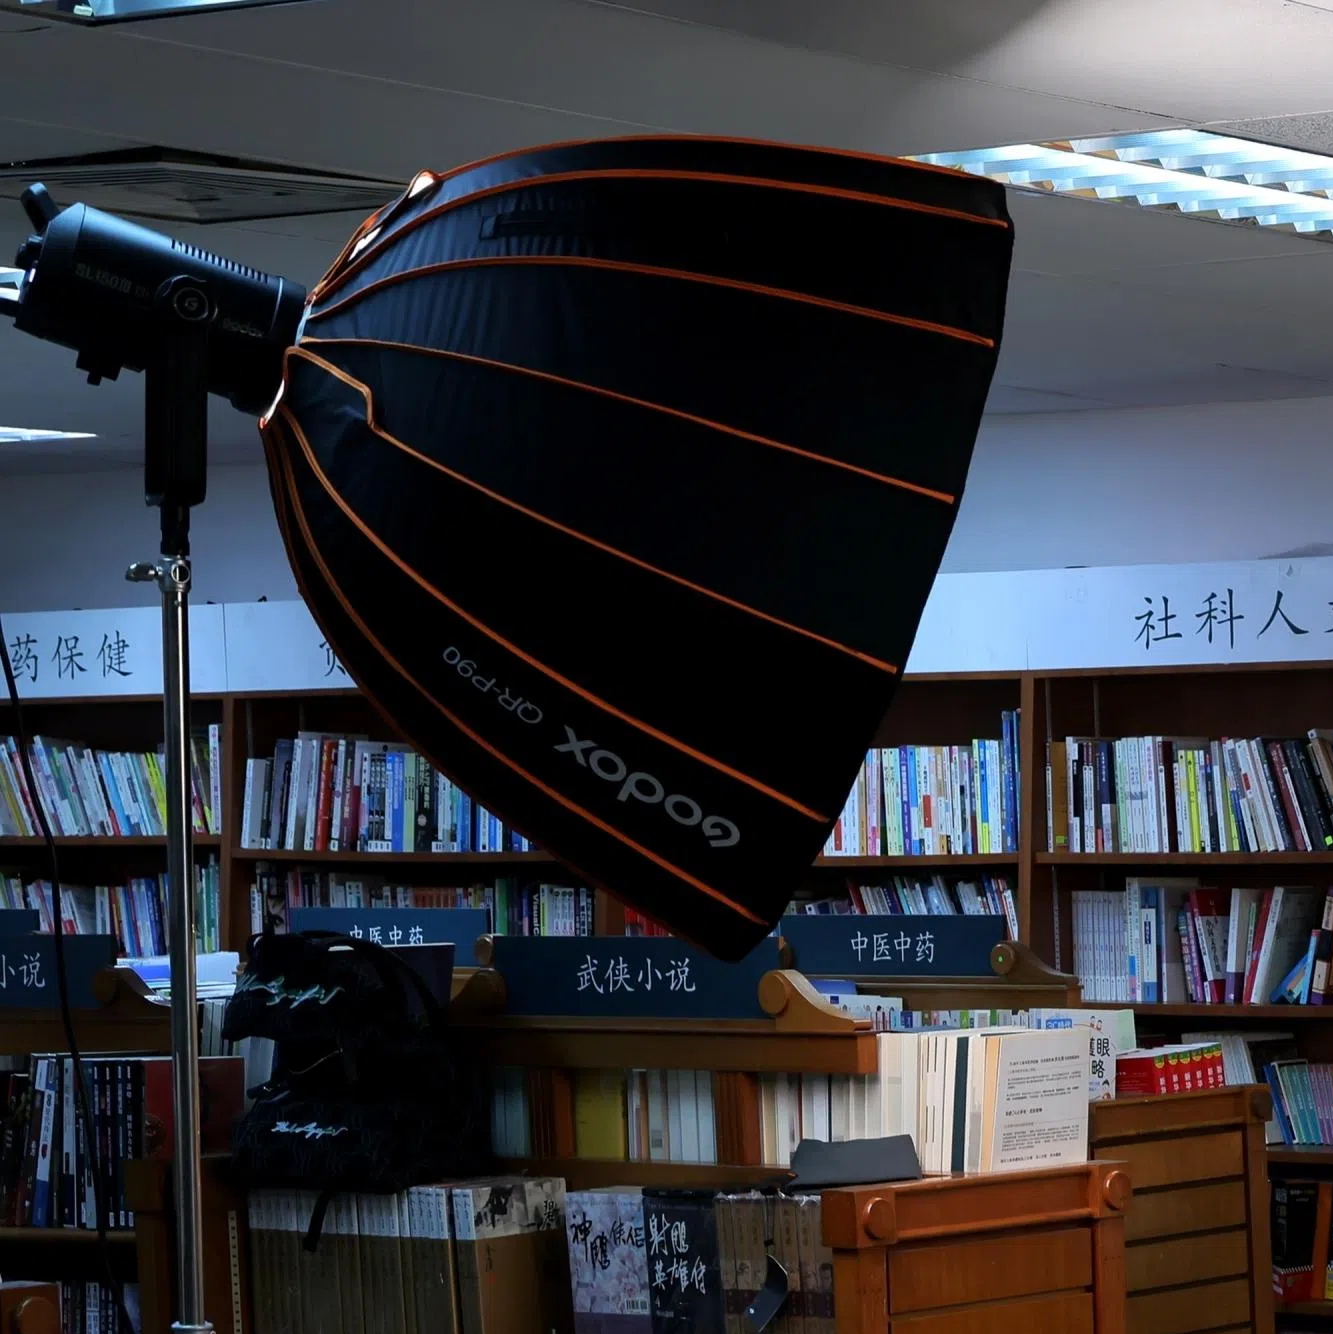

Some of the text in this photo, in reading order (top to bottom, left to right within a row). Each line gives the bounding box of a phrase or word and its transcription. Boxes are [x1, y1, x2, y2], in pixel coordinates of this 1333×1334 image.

[11, 631, 134, 681] 药保健
[442, 646, 545, 725] QR-P90
[850, 932, 935, 964] 中医中药
[576, 954, 697, 994] 武侠小说
